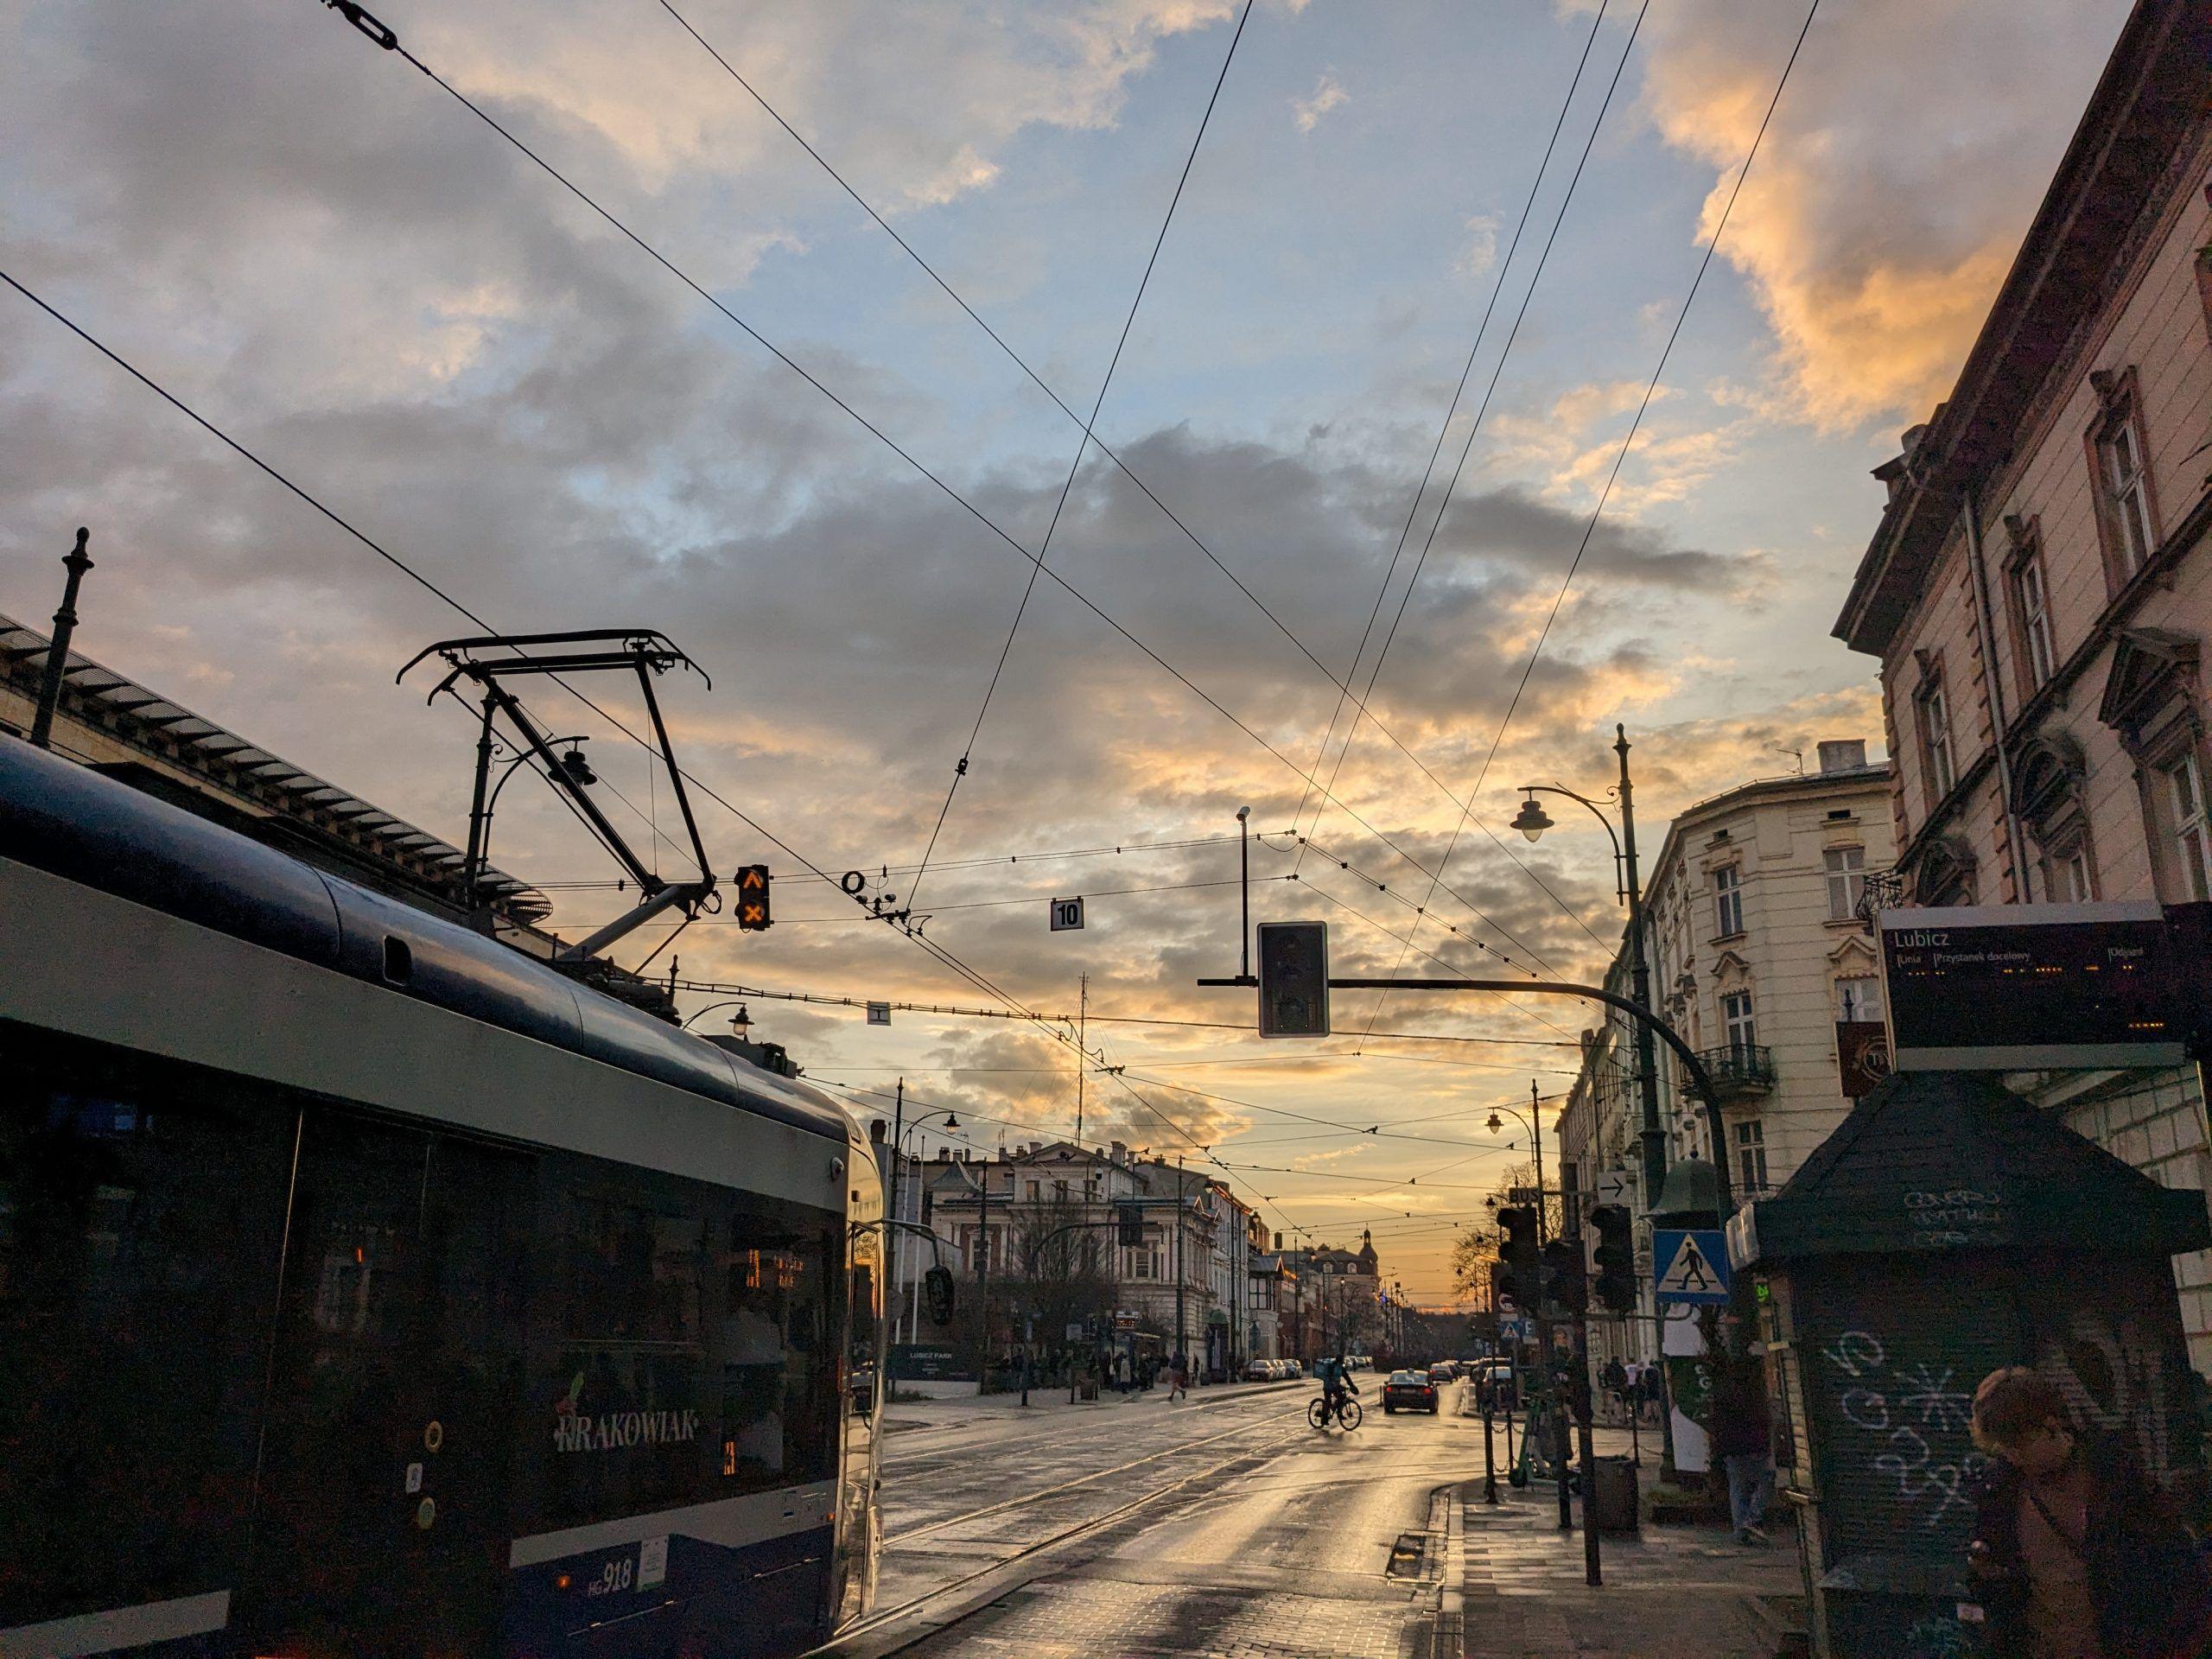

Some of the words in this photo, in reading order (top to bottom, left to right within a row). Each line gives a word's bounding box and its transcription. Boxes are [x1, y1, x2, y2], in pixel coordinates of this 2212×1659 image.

[1058, 904, 1078, 925] 10
[1894, 929, 1950, 948] Lubicz
[1936, 950, 1985, 963] Przystanek
[554, 1409, 699, 1452] KRAKOWIAK
